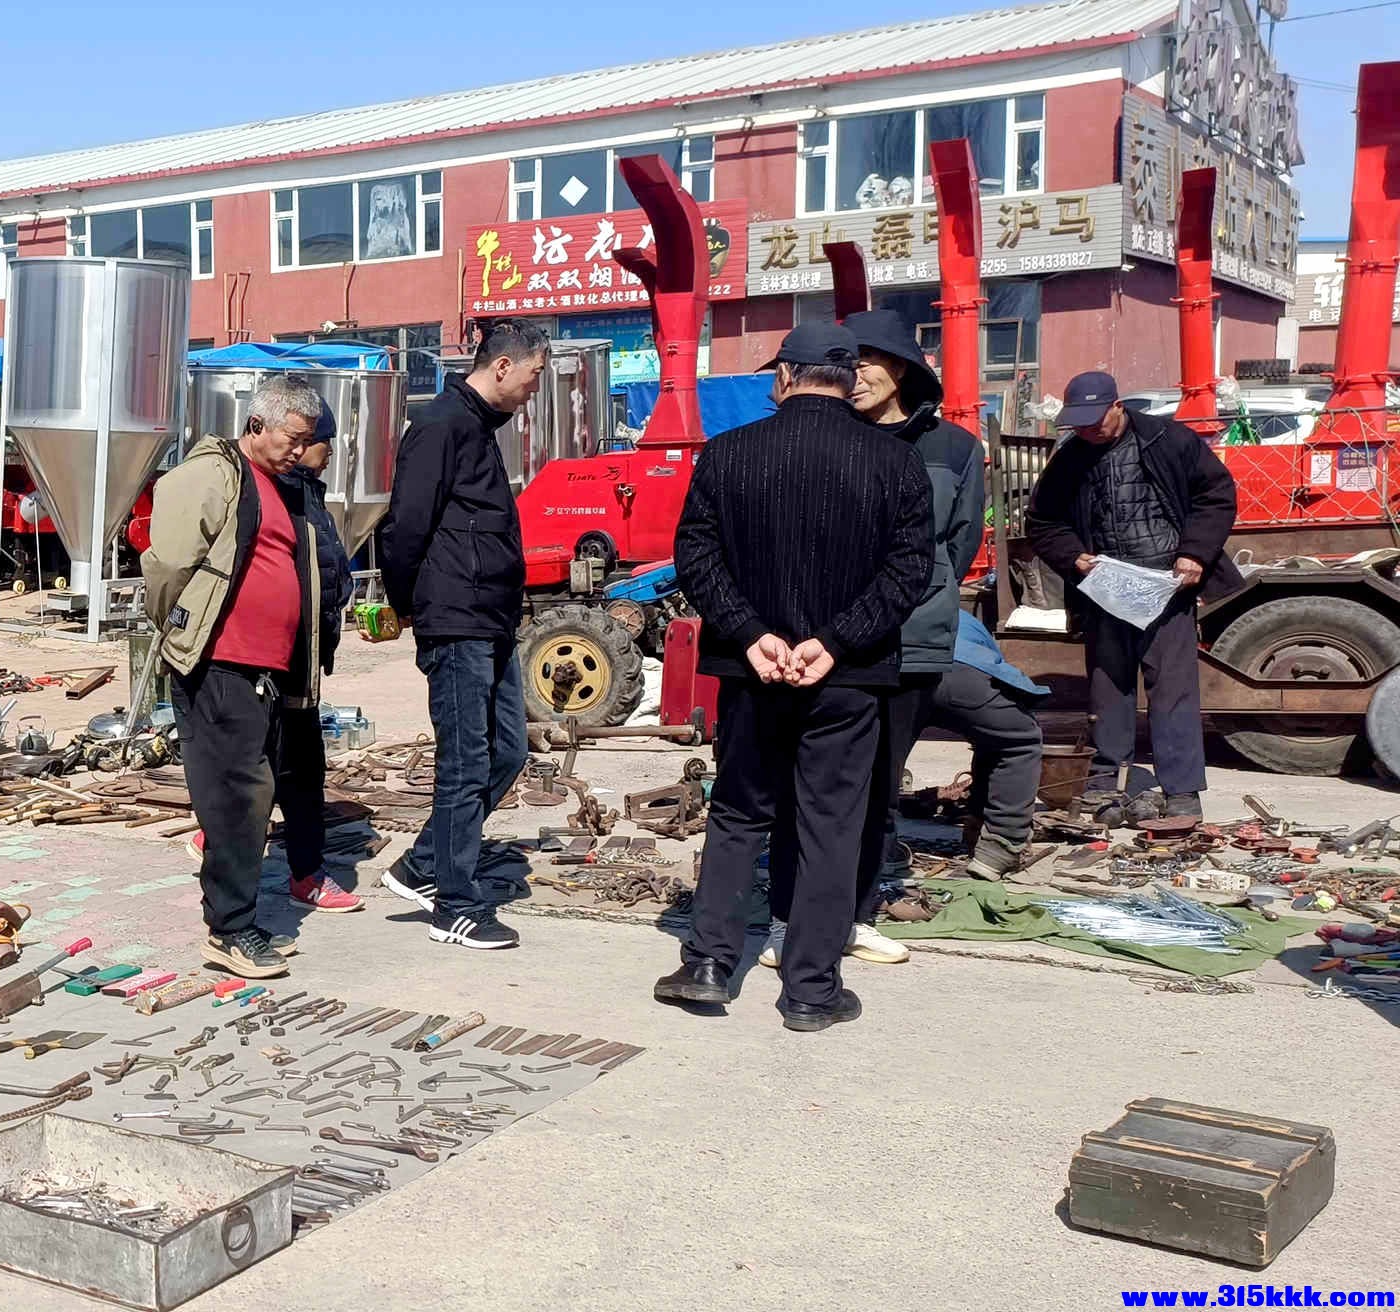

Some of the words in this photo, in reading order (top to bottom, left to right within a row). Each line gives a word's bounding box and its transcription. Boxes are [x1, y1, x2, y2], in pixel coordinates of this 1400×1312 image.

[760, 271, 821, 292] 吉林省总代理
[1019, 252, 1093, 271] 15843381827
